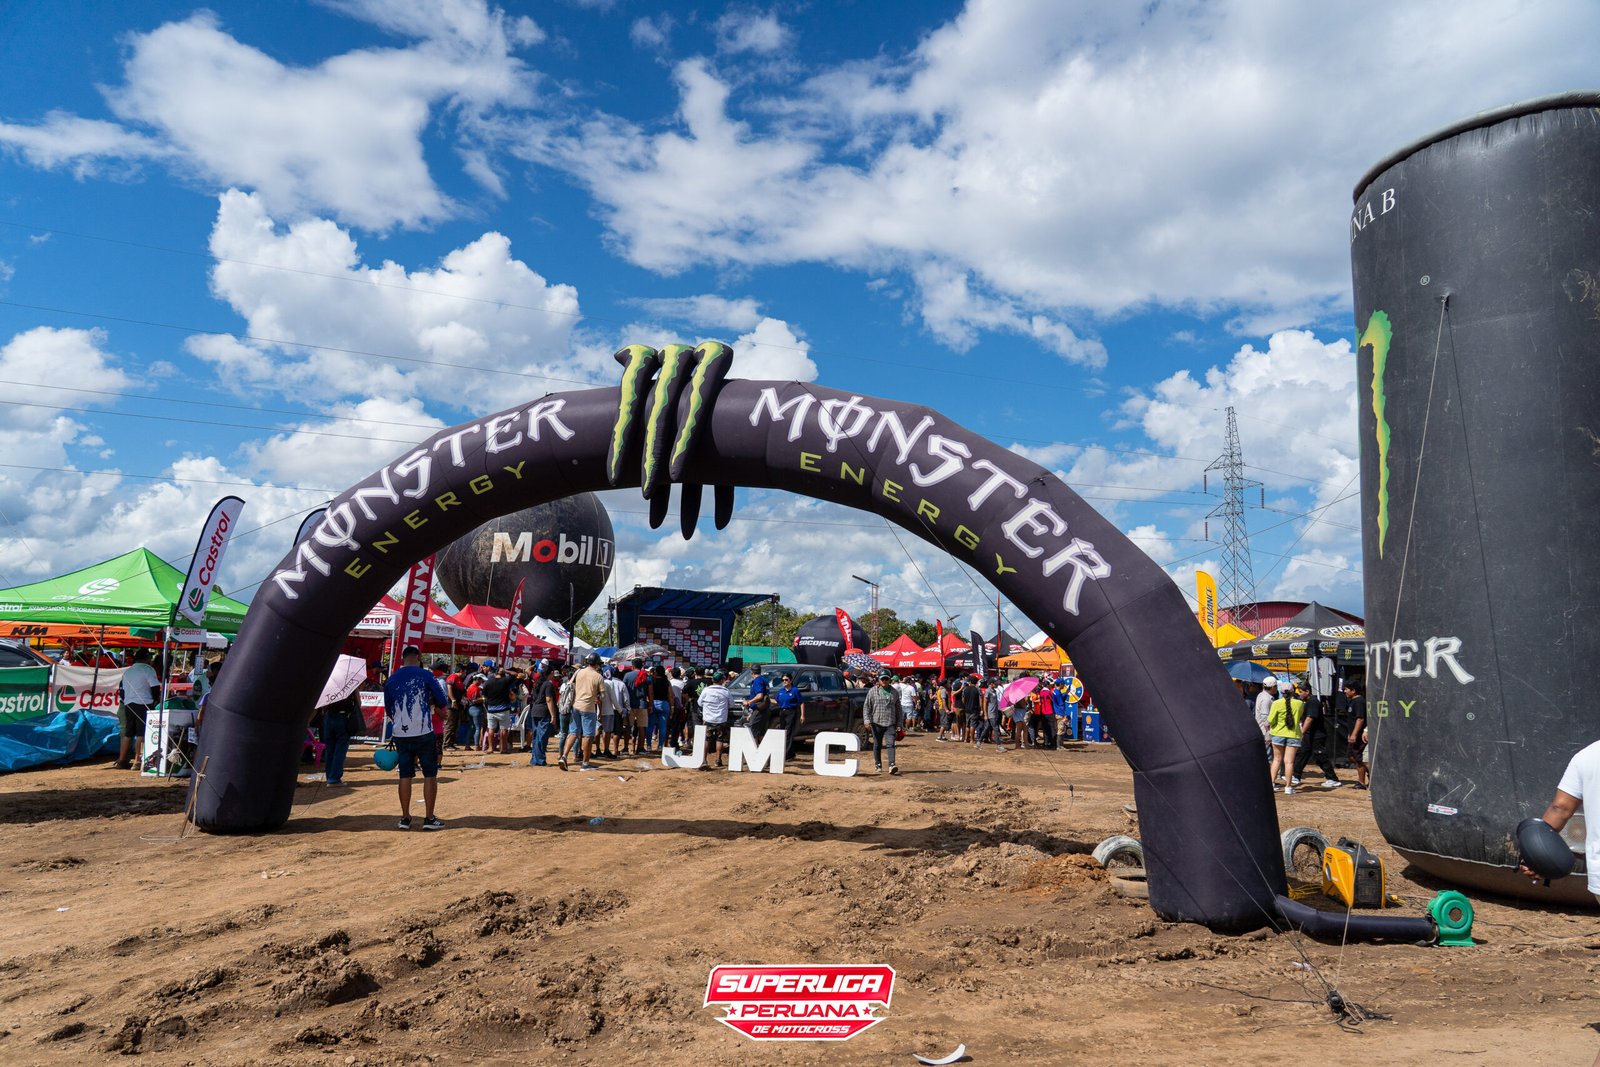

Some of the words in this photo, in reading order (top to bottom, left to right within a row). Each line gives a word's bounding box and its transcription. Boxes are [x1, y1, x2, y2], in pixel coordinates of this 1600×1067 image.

[1381, 188, 1396, 216] B
[343, 460, 527, 580] ENERGY
[800, 452, 1018, 576] ENERGY
[199, 511, 232, 586] Castrol
[490, 531, 594, 566] Mobil
[601, 541, 610, 565] 1
[1206, 585, 1215, 629] ADVANCE
[10, 625, 49, 636] KTM
